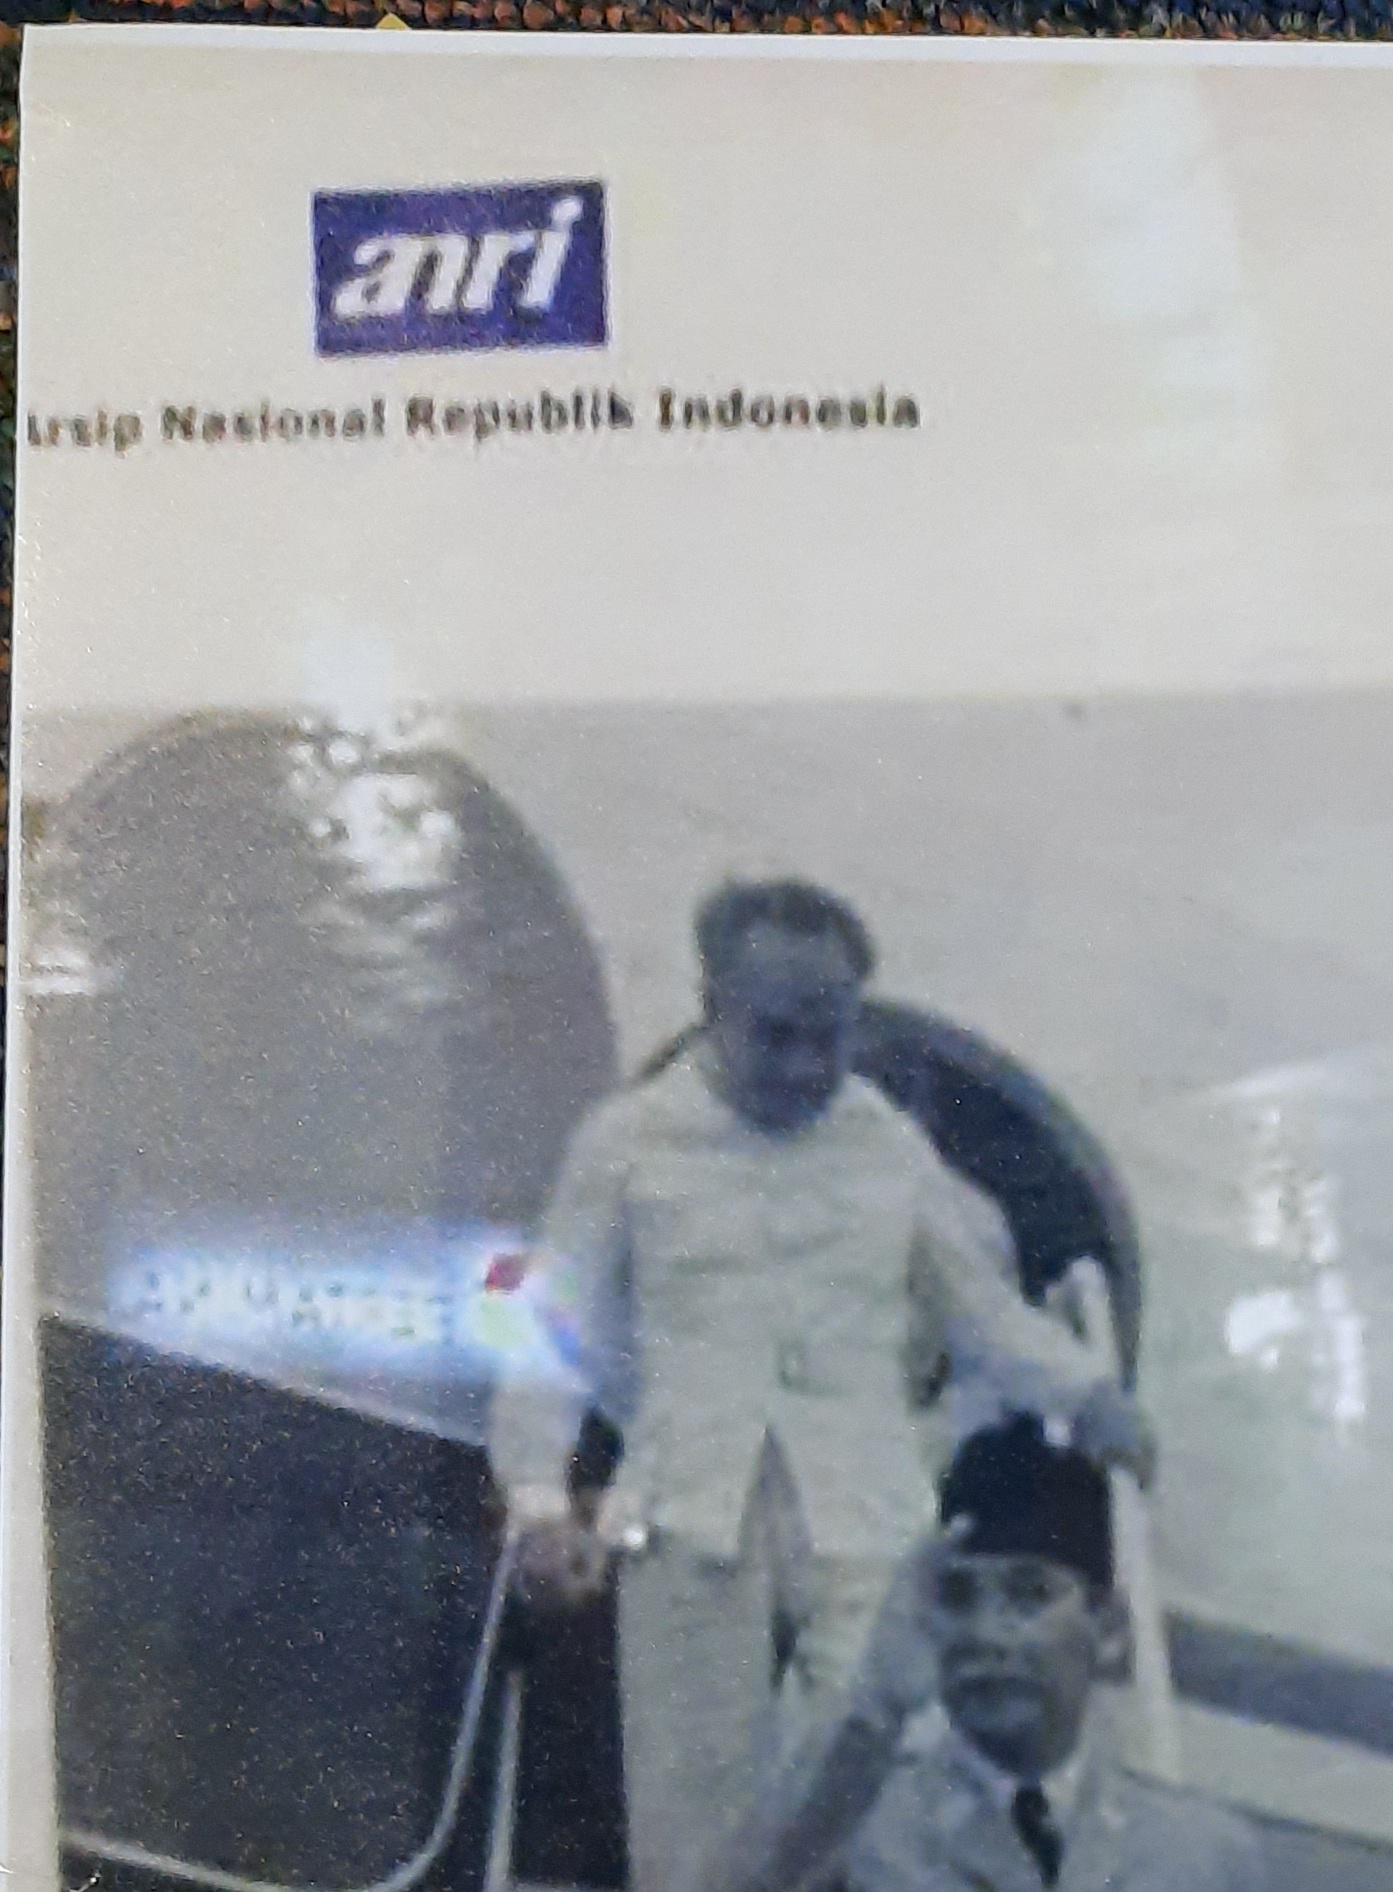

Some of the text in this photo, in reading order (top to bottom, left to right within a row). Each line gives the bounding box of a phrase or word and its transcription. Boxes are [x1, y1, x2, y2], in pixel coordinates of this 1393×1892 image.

[332, 195, 583, 318] anri
[159, 397, 387, 445] Nasional
[403, 388, 635, 447] Republik
[656, 382, 921, 434] Indonesia
